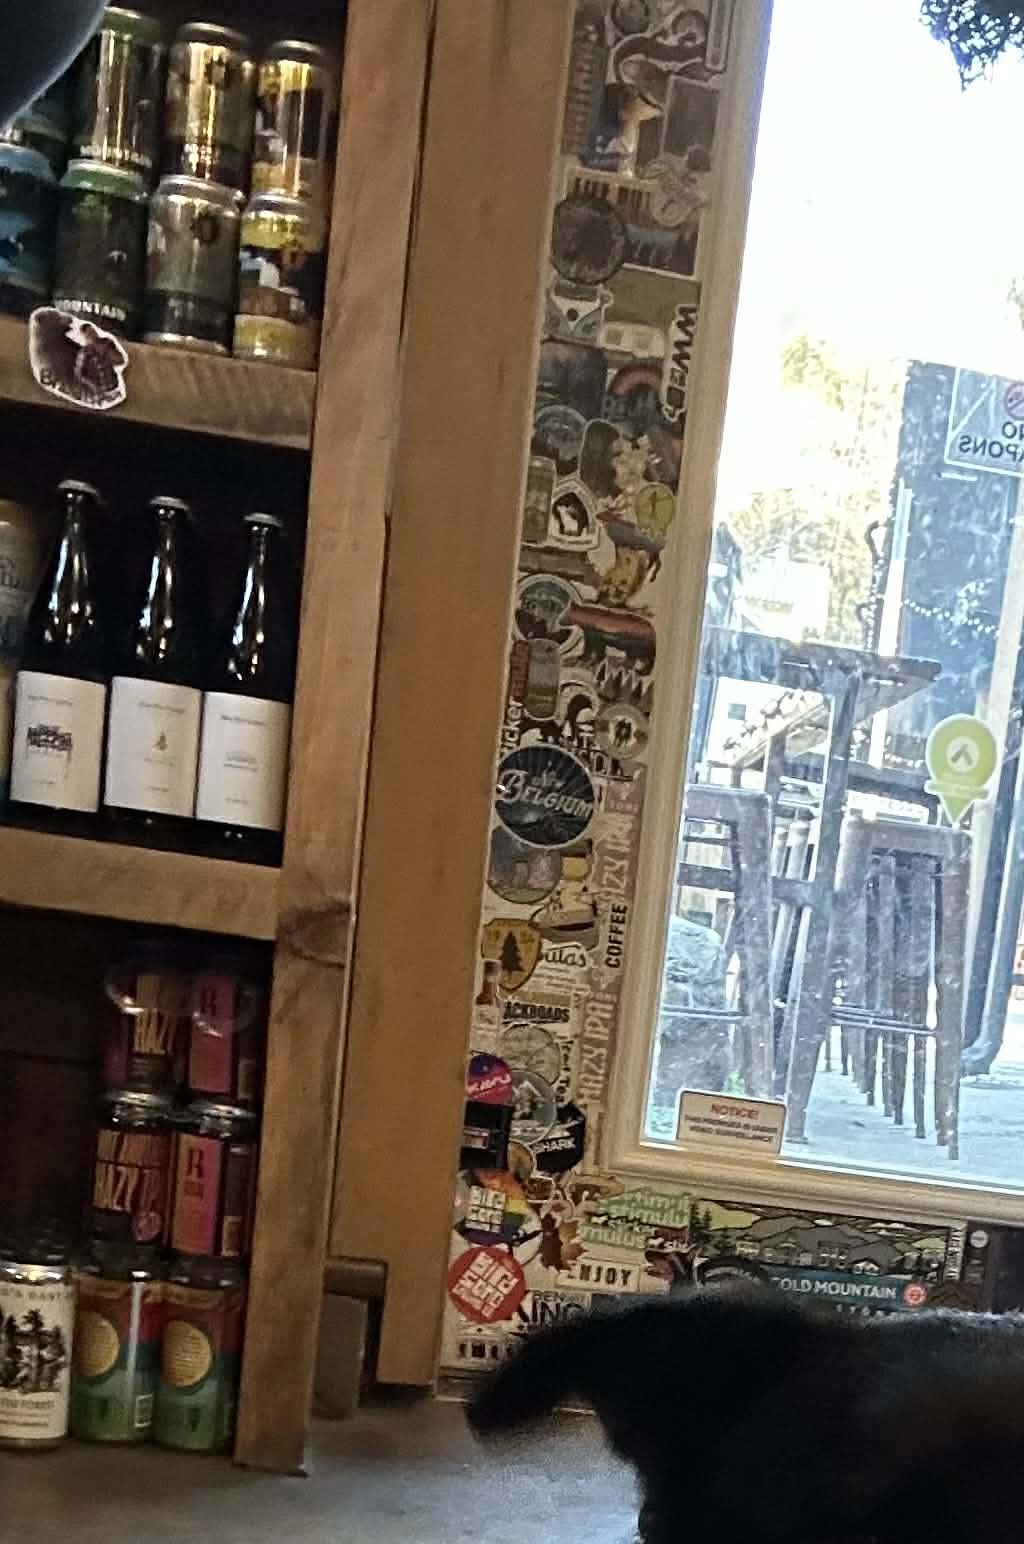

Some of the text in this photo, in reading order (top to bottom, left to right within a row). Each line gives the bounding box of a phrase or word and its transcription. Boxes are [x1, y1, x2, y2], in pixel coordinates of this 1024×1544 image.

[496, 770, 594, 817] BELGIUM
[605, 904, 628, 969] COFFEE
[812, 1281, 898, 1300] MOUNTAIN
